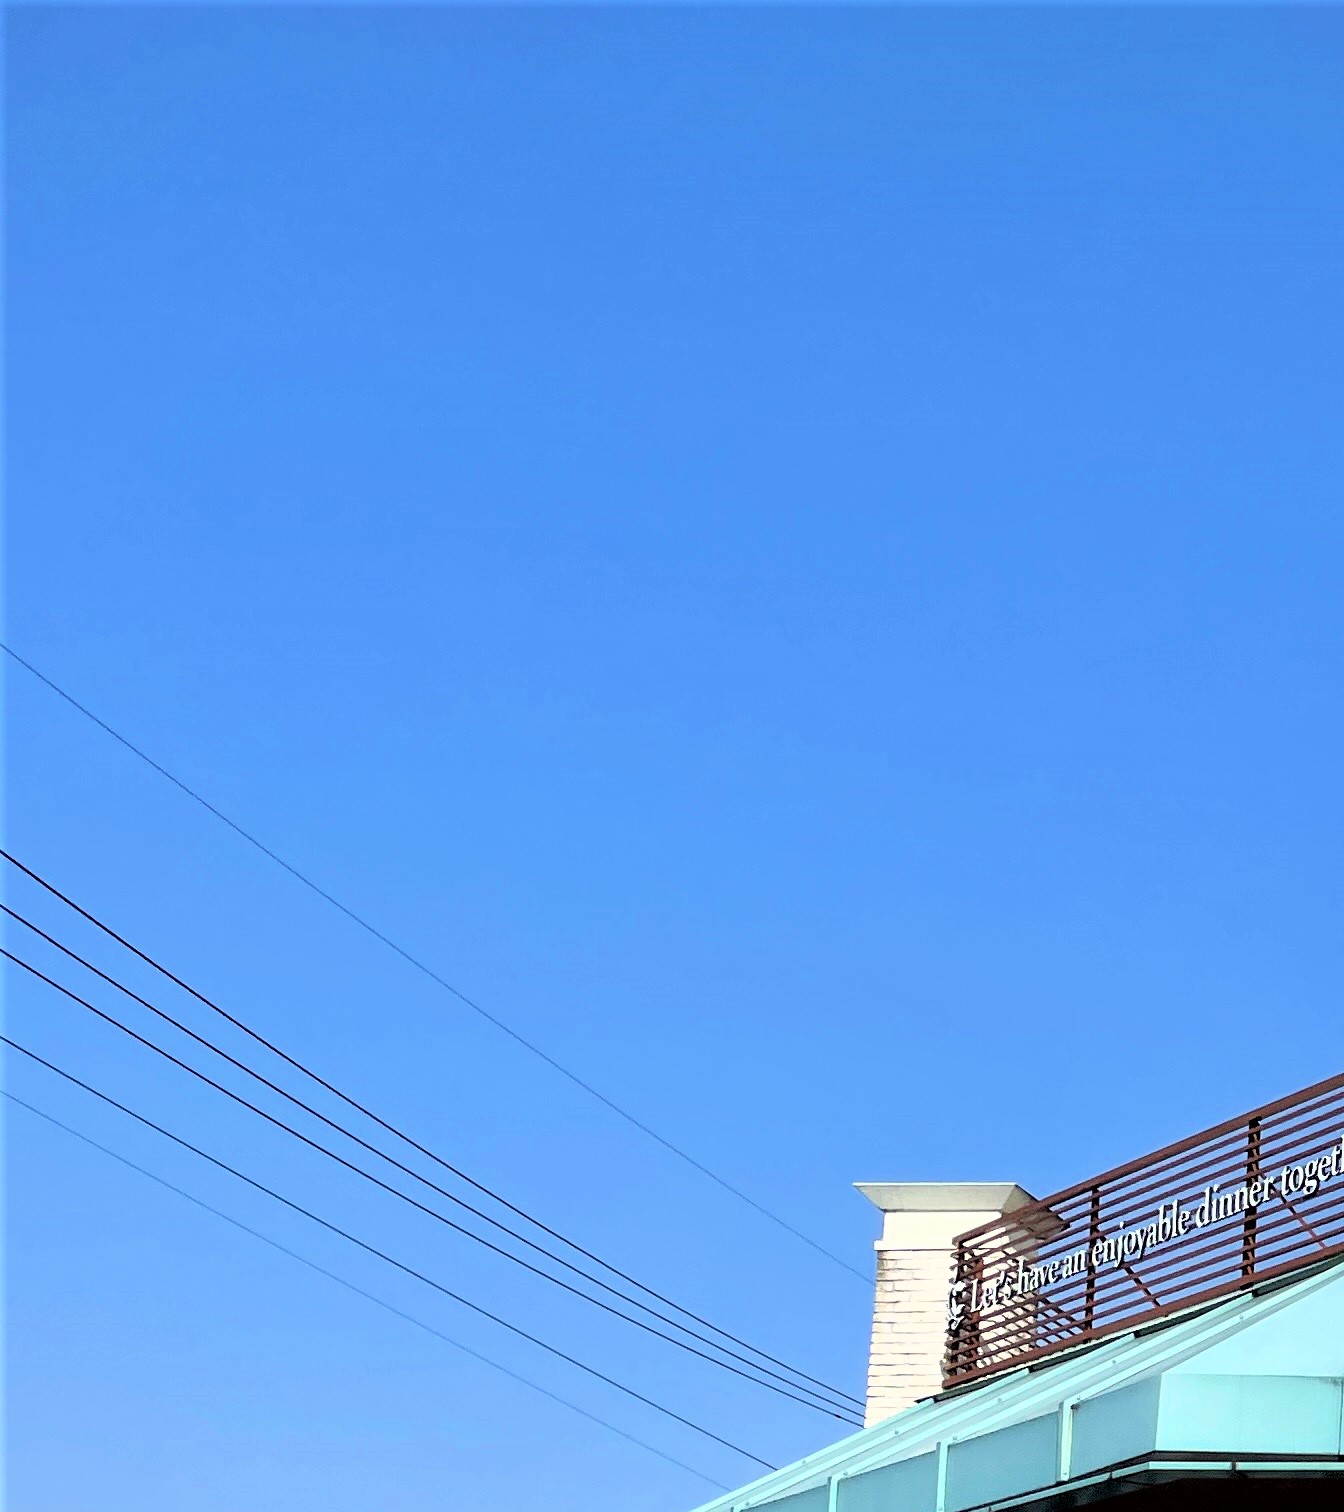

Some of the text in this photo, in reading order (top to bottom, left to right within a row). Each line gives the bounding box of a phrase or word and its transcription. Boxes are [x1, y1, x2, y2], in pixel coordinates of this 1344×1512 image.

[1018, 1256, 1060, 1295] have
[1062, 1253, 1088, 1281] an
[1092, 1197, 1190, 1268] enjoyable
[1195, 1176, 1276, 1228] dinner
